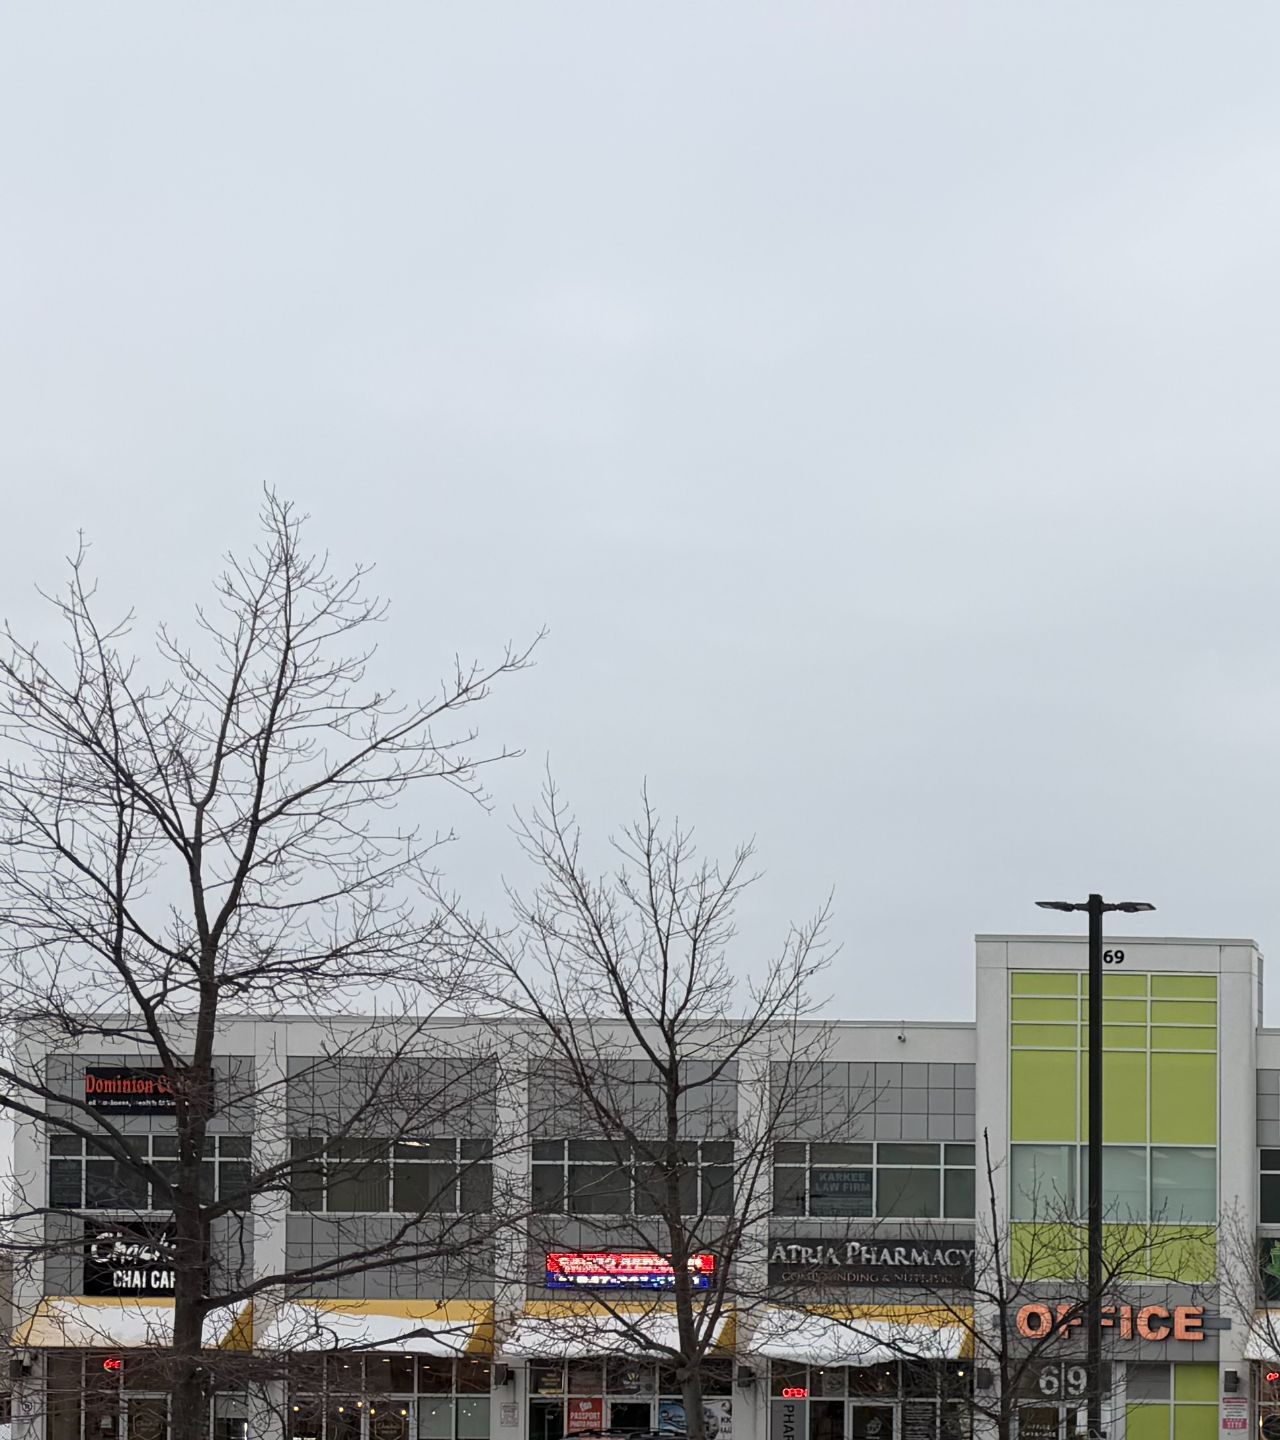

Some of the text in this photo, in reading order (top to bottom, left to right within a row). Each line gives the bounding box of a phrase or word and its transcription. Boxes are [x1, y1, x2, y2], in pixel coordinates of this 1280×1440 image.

[1103, 950, 1125, 964] 69
[85, 1074, 153, 1093] Dominion
[819, 1173, 866, 1182] KARKEE
[815, 1183, 871, 1192] LAW FIRM
[769, 1242, 974, 1265] ATRIA PHARMACY
[113, 1270, 147, 1288] CHAI
[1016, 1303, 1205, 1341] OFFICE
[1039, 1365, 1088, 1396] 69
[782, 1387, 808, 1398] OPEN
[570, 1411, 600, 1420] PASSPORT
